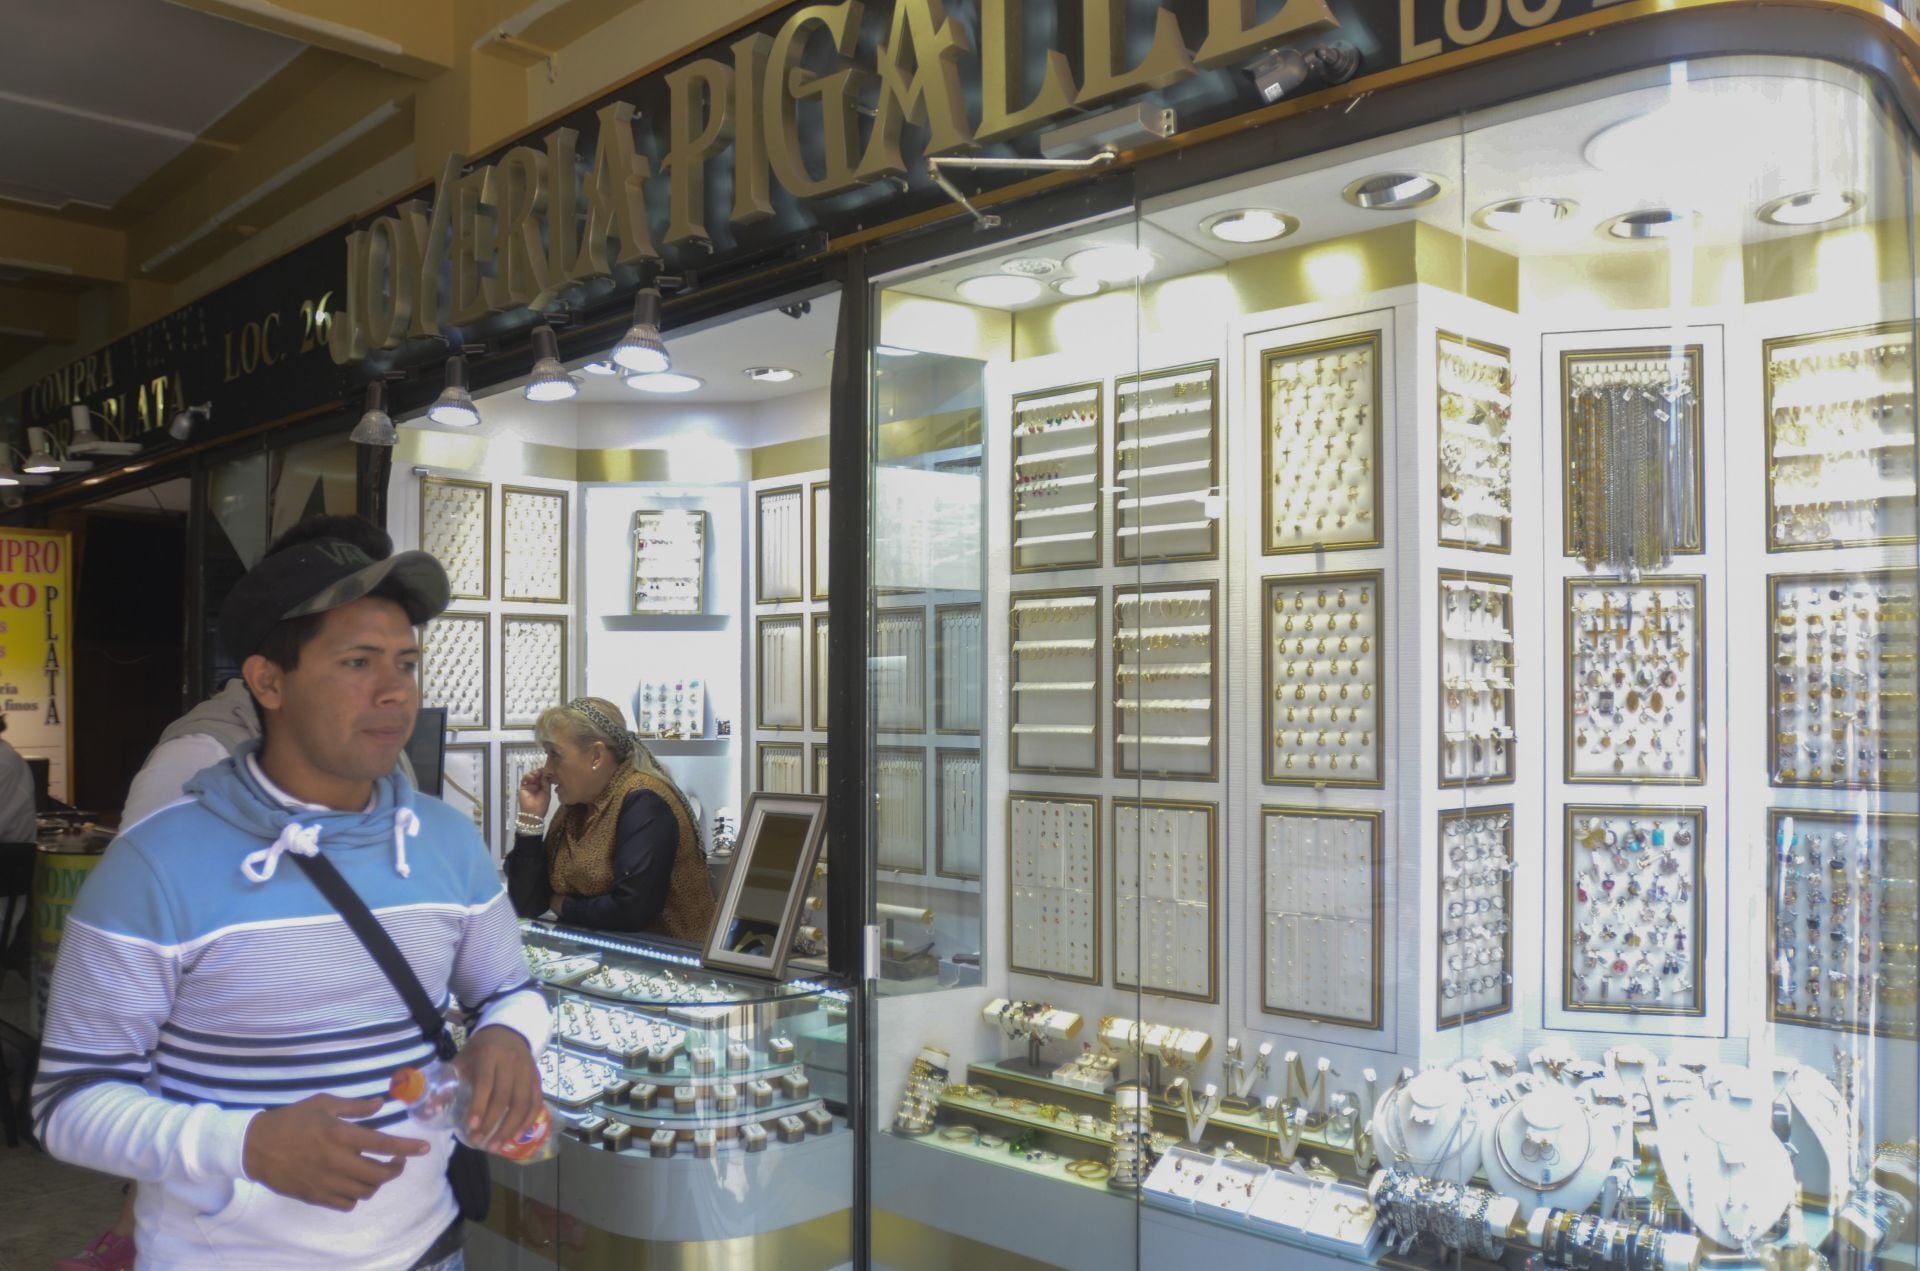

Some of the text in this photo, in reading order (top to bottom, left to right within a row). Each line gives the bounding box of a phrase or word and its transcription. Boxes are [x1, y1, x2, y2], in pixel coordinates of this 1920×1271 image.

[329, 100, 658, 365] JOYERIA
[300, 290, 333, 354] 26
[30, 348, 114, 420] COMPRA
[0, 539, 60, 574] PRO
[45, 586, 60, 725] PLATA
